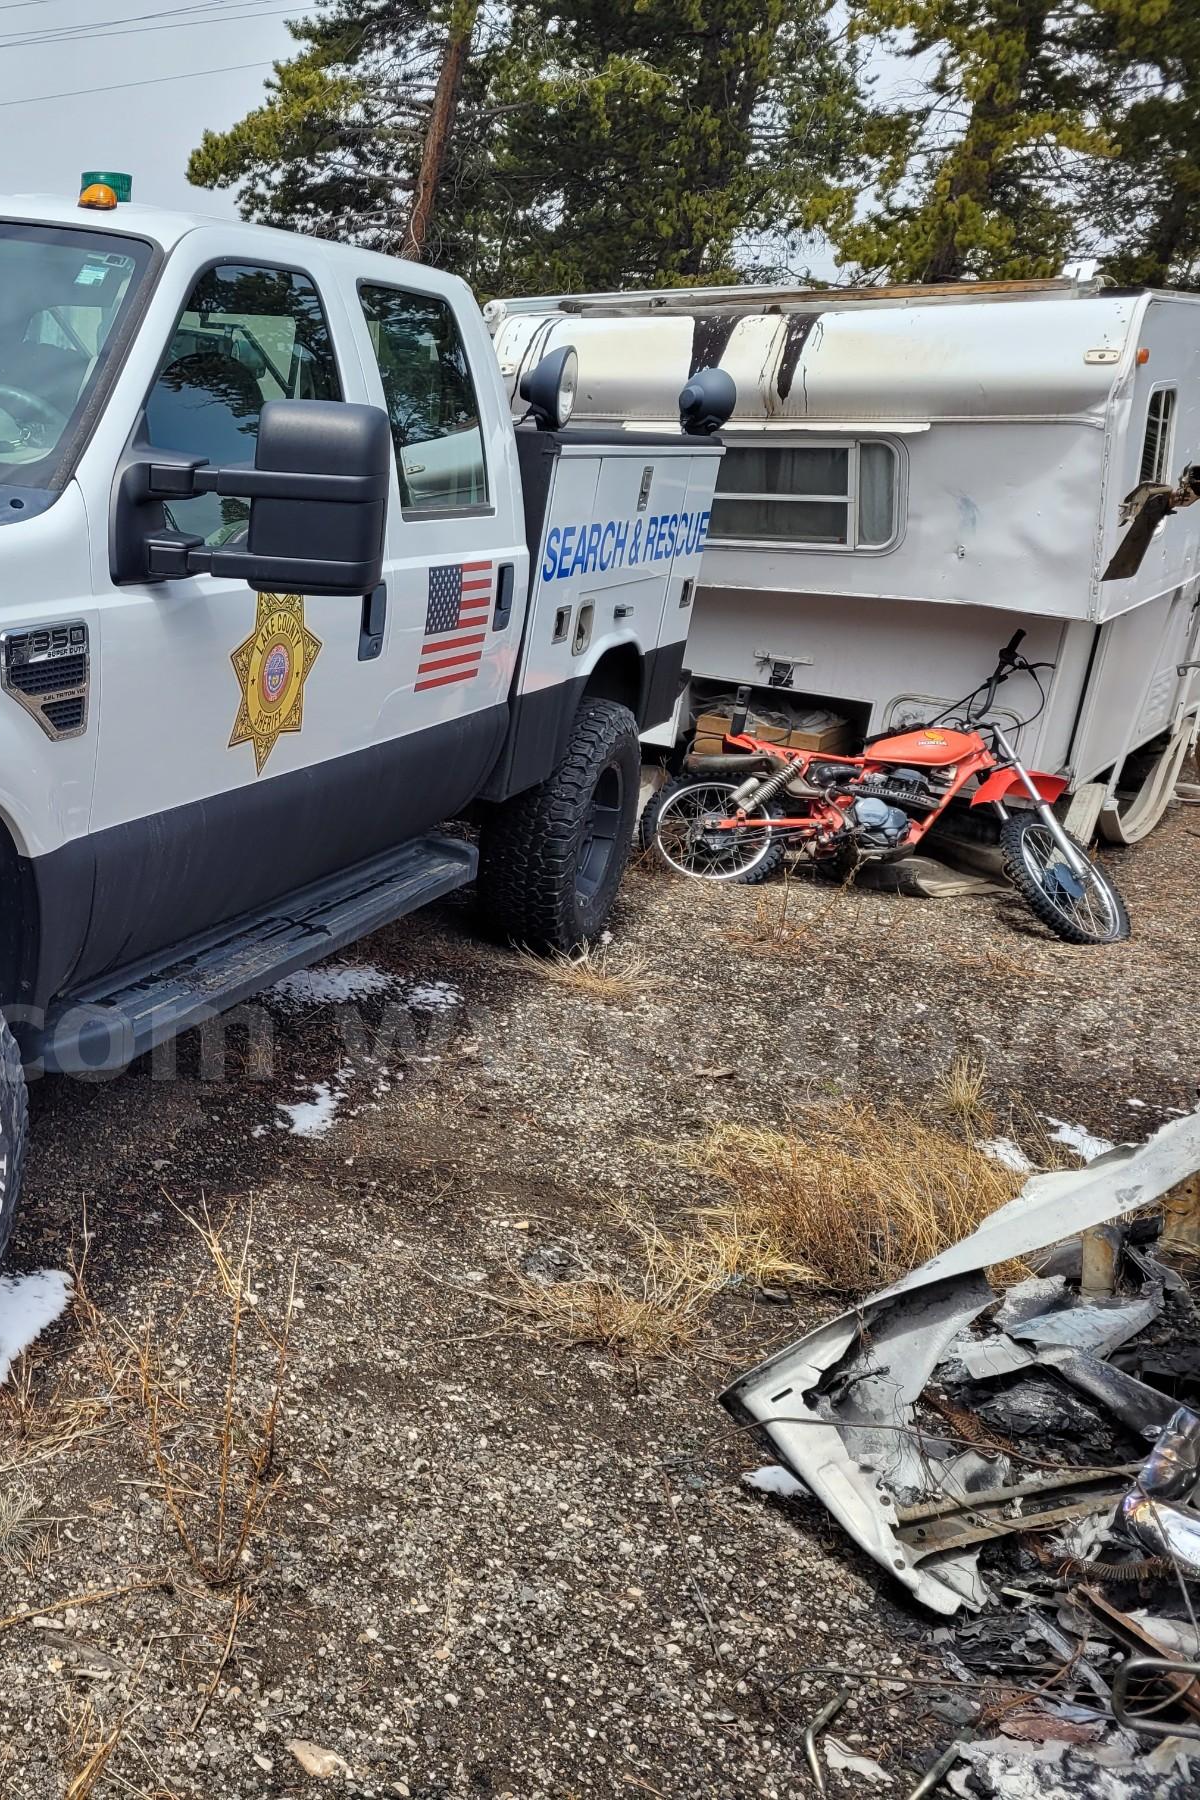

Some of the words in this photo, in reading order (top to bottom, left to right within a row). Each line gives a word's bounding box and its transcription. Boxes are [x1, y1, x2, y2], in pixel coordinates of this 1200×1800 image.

[542, 520, 630, 582] SEARCH
[628, 518, 643, 566] &
[642, 511, 711, 562] RESCUE
[8, 625, 86, 657] F-350
[256, 619, 275, 655] LAKE
[277, 613, 302, 649] COUNTY
[47, 648, 68, 658] SUPER
[69, 645, 86, 654] DUTY
[56, 690, 75, 699] TRITON
[254, 707, 282, 733] SHERIFF
